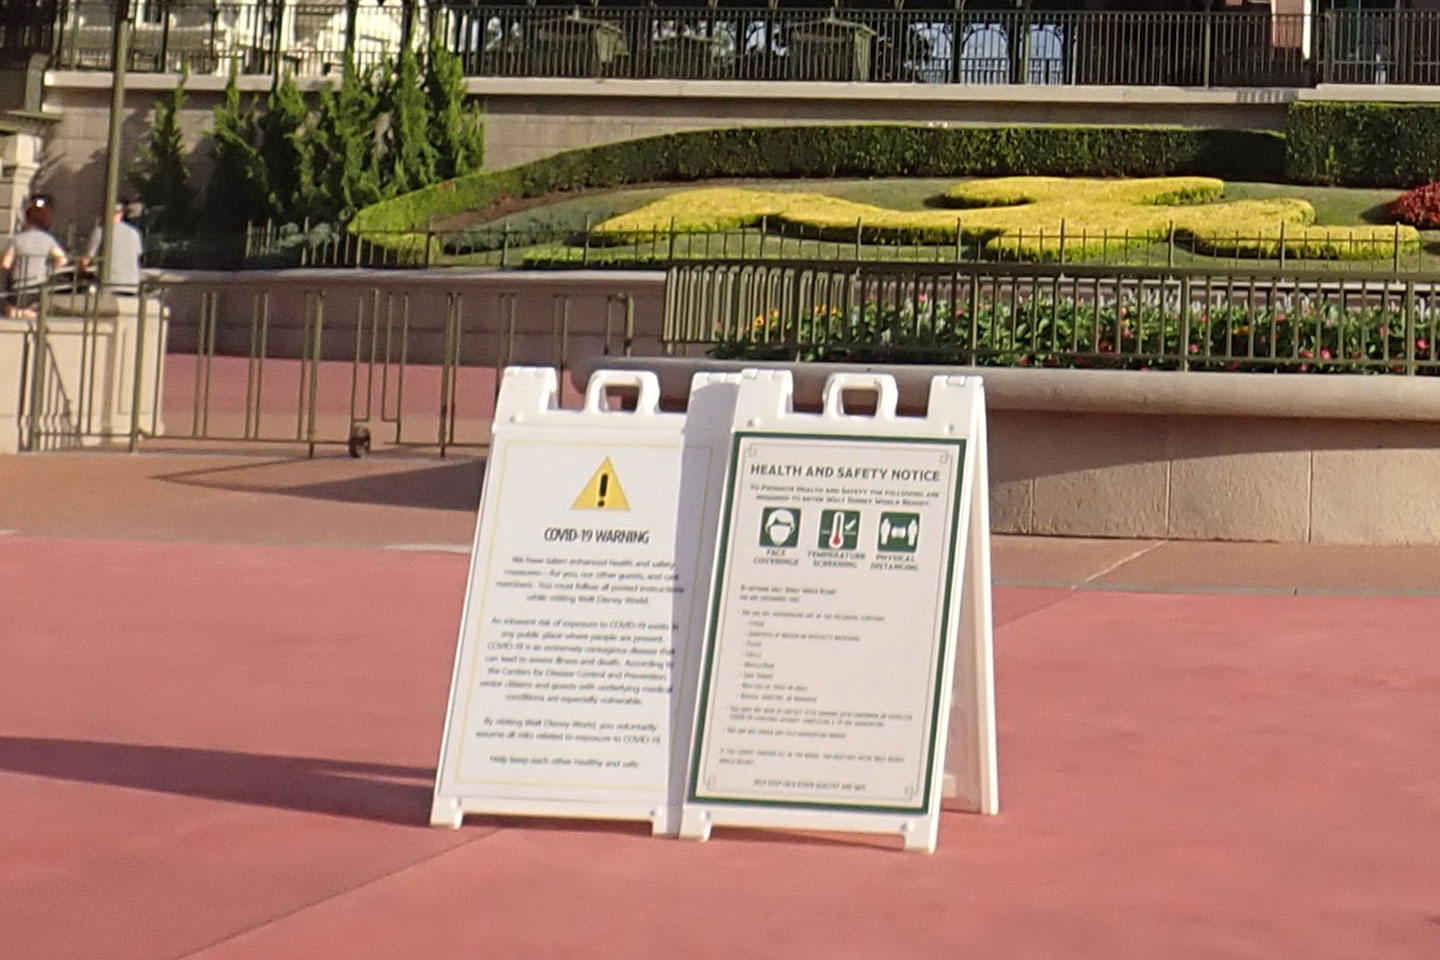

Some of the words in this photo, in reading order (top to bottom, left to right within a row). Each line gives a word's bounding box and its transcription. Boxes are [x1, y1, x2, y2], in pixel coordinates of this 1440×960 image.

[750, 464, 802, 477] HEALTH
[805, 466, 834, 478] AND
[837, 467, 888, 480] SAFETY
[890, 469, 941, 482] NOTICE
[544, 527, 593, 543] COVID-19
[595, 529, 650, 545] WARNING
